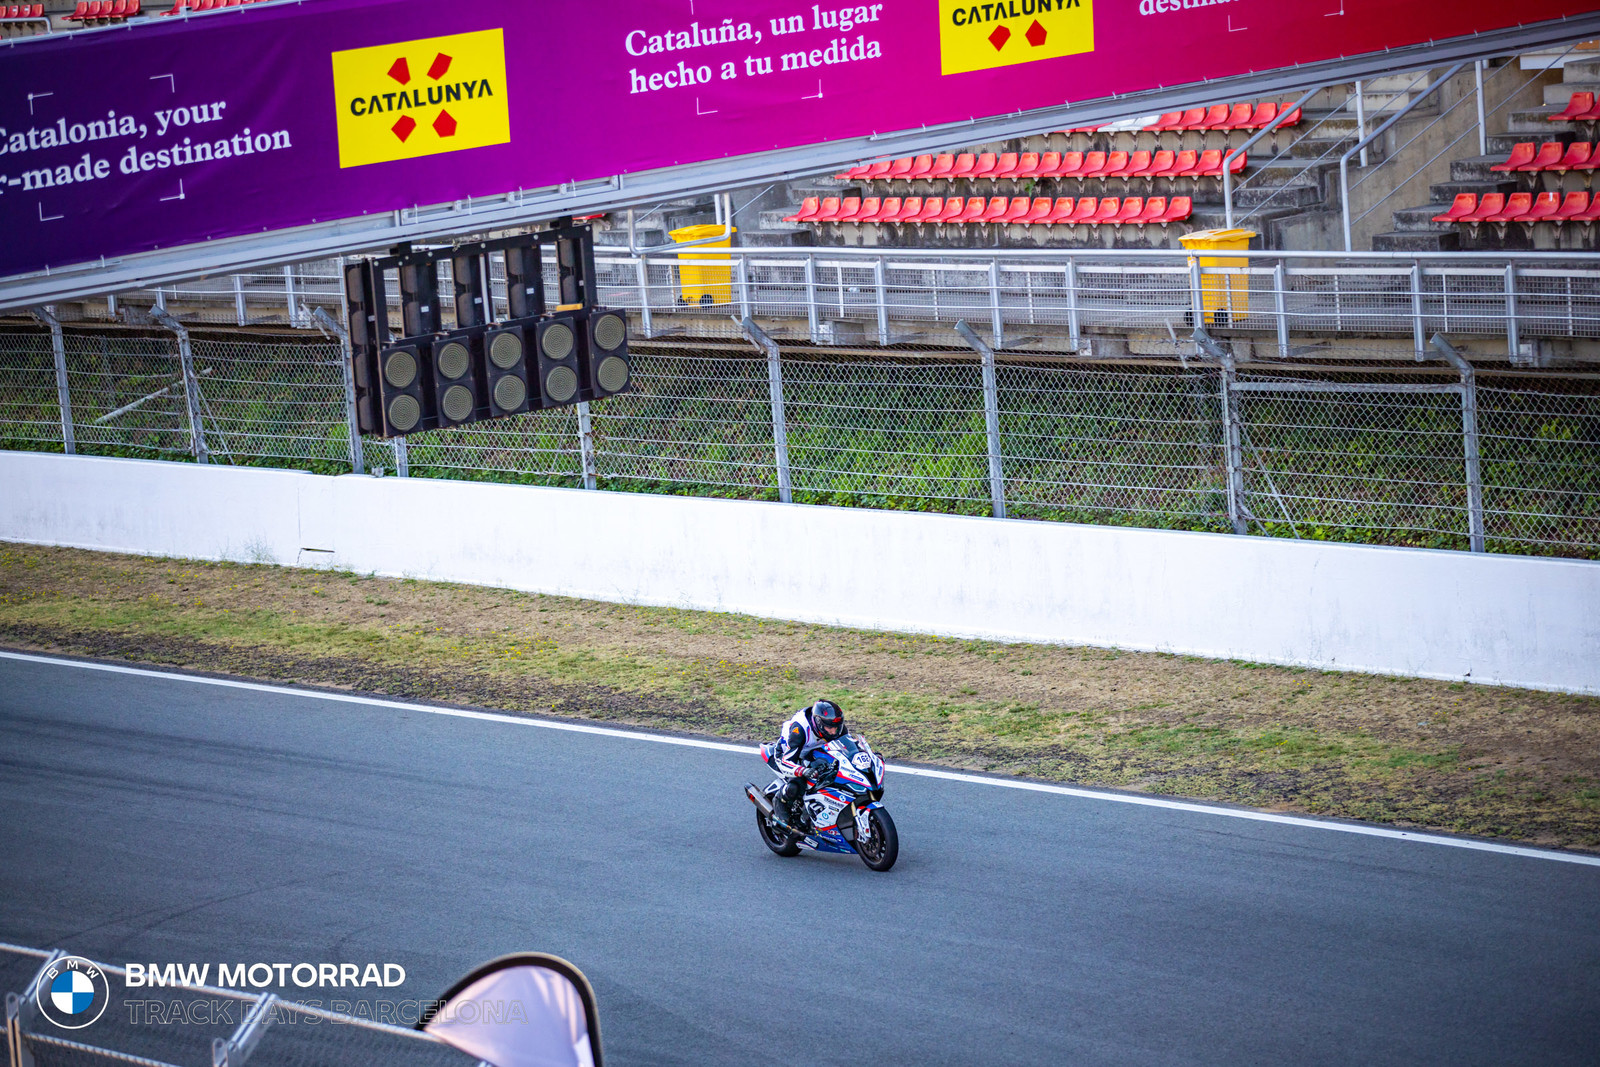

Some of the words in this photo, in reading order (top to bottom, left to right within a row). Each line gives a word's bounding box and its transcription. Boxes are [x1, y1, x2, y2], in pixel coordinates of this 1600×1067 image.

[625, 18, 762, 56] Cataluña,
[770, 14, 805, 36] un
[811, 3, 883, 31] lugar
[629, 61, 712, 94] hecho
[720, 61, 737, 80] a
[744, 56, 773, 76] tu
[781, 35, 882, 72] medida
[154, 101, 226, 136] your
[350, 79, 493, 116] CATALUNYA
[119, 127, 292, 175] destination
